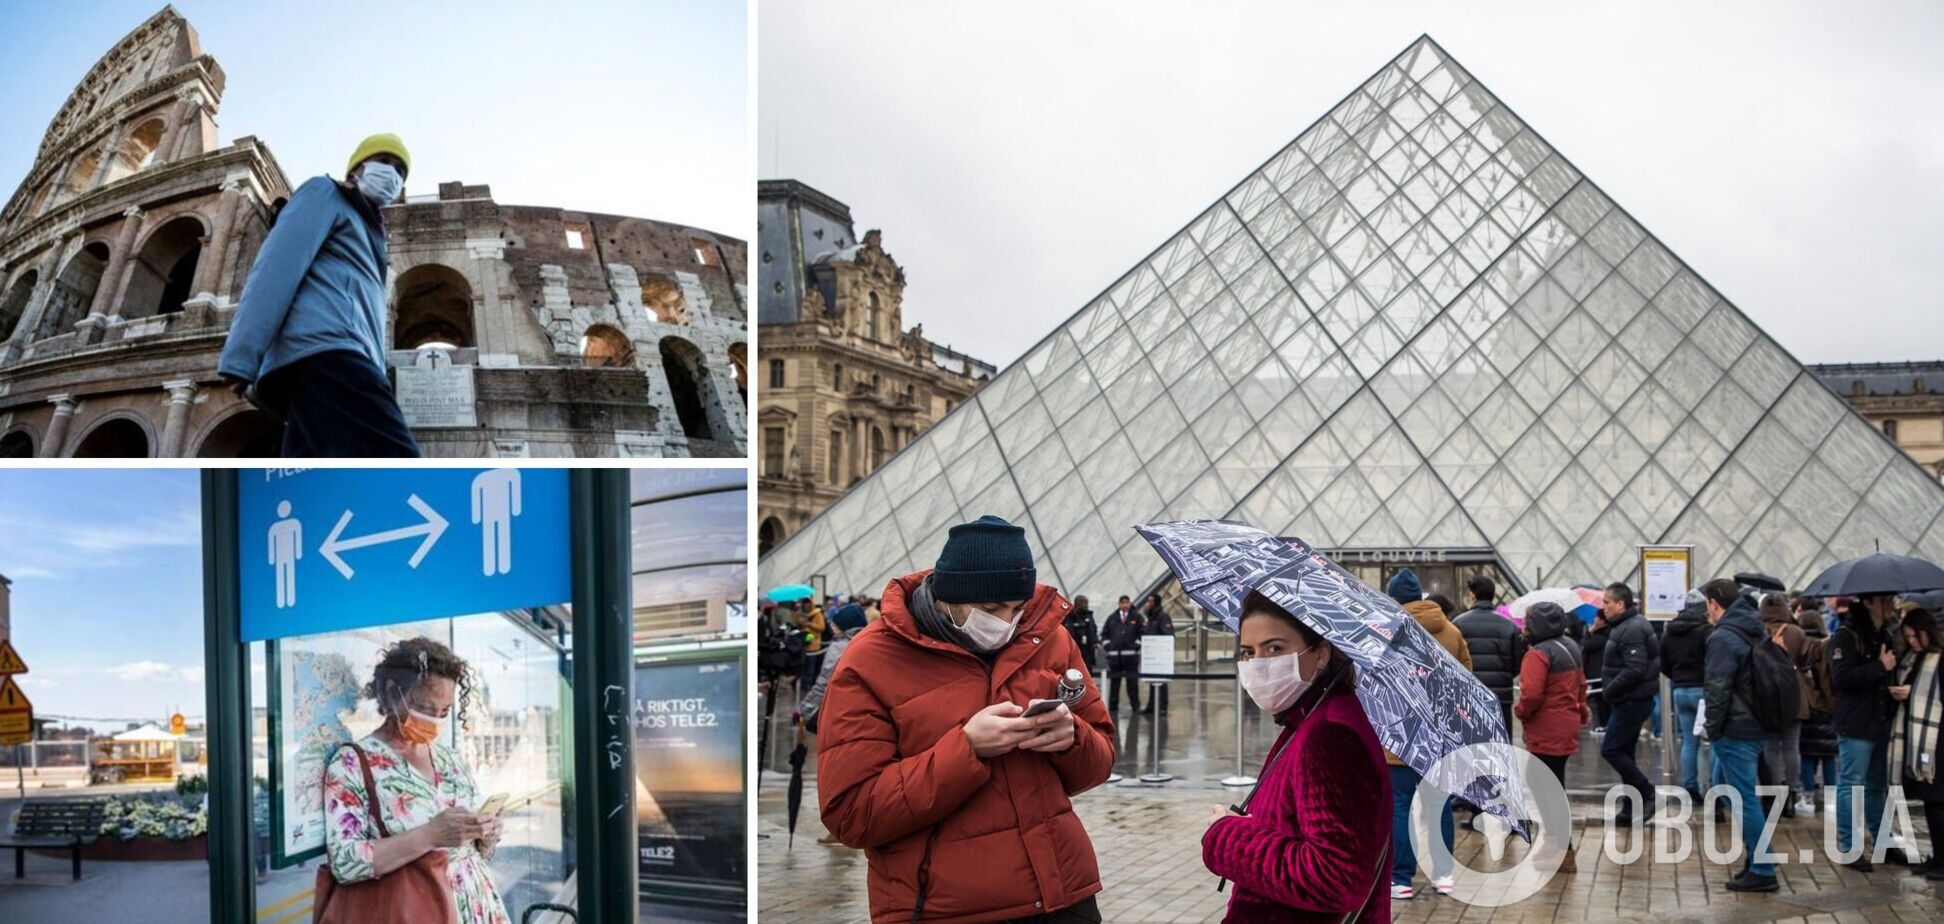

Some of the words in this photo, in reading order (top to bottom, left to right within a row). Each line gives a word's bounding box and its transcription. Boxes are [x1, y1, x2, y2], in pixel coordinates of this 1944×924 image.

[1359, 550, 1447, 562] LOUVRE
[647, 697, 707, 712] RIKTIGT.
[669, 712, 718, 728] TELE2.
[640, 846, 675, 860] TELE2
